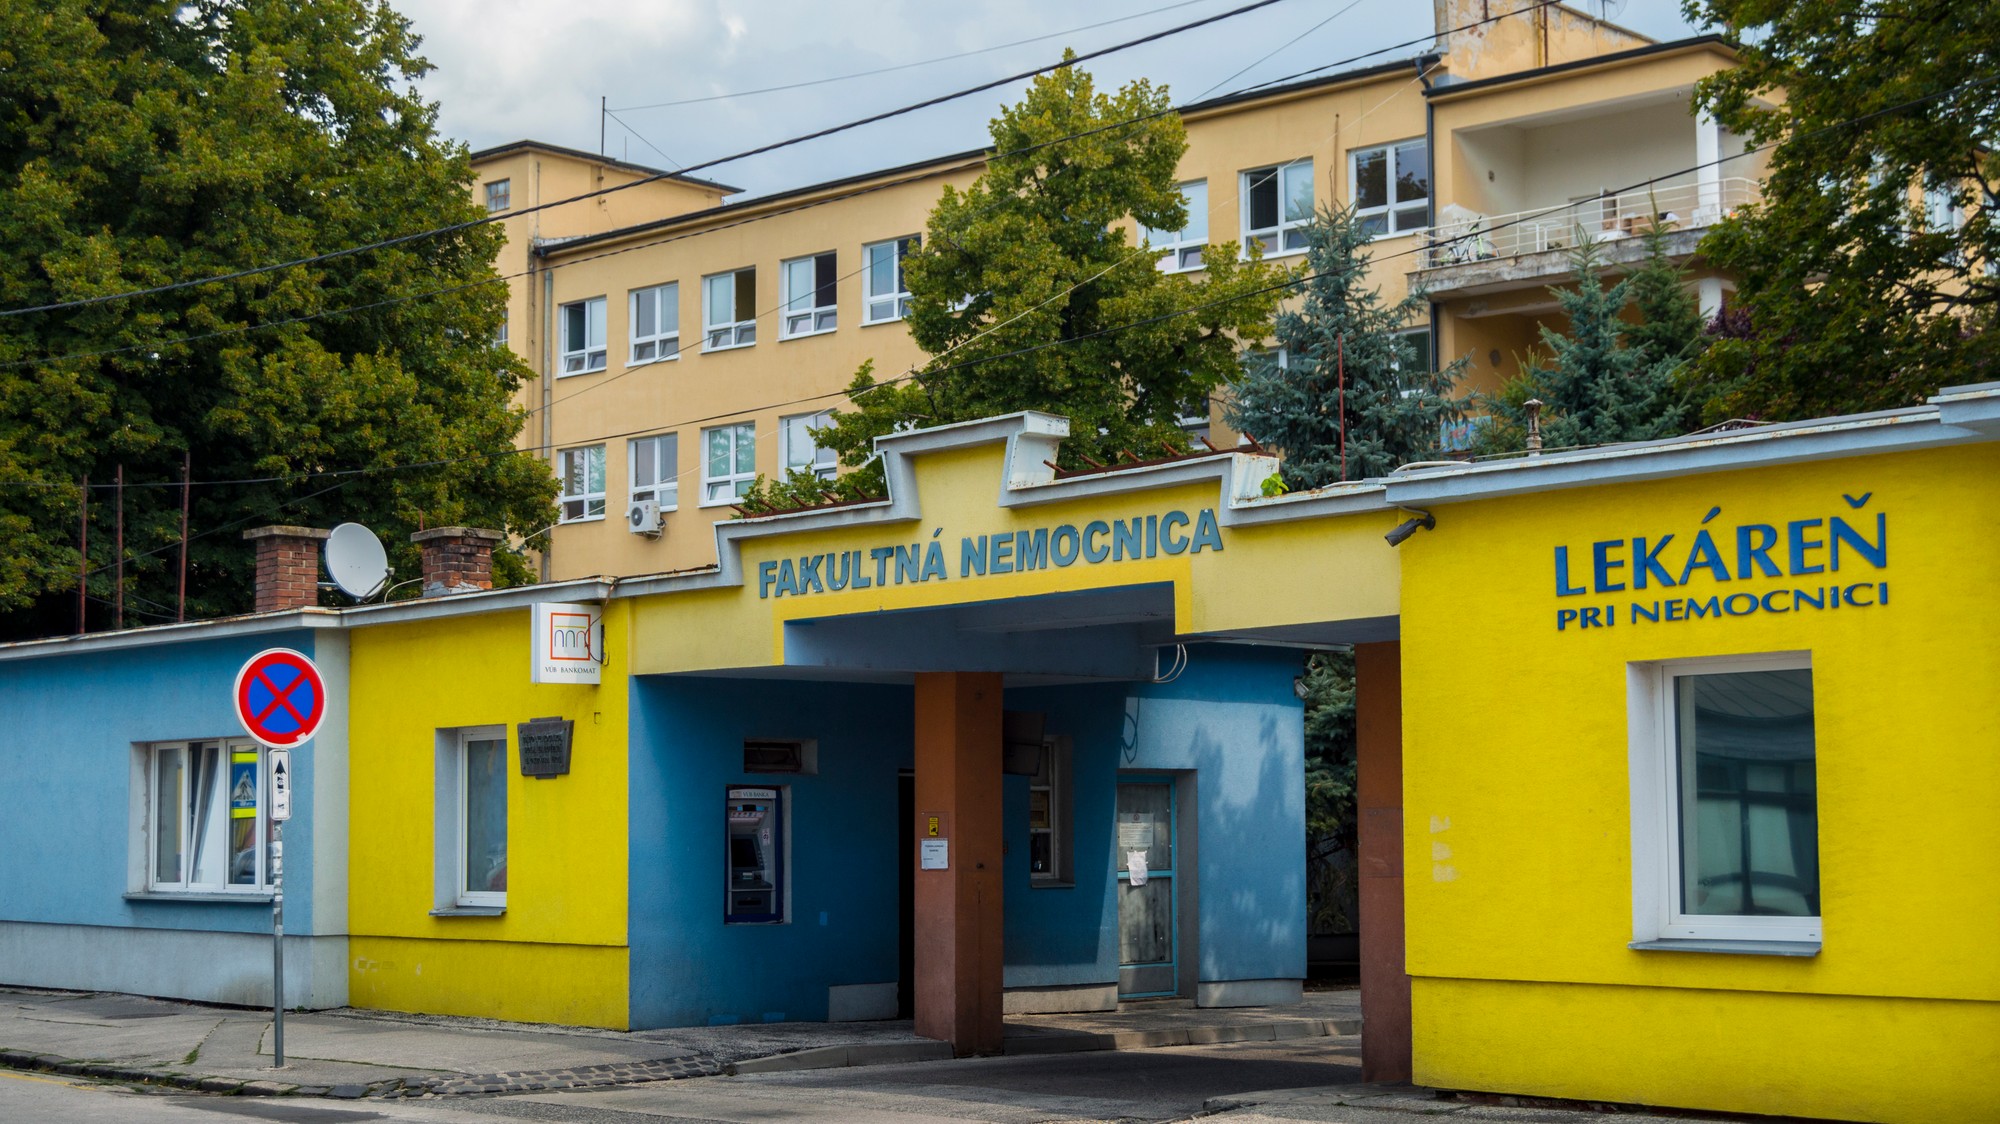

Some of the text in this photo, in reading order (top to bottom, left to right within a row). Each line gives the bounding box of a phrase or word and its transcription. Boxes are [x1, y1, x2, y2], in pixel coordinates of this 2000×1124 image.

[759, 508, 1224, 599] FAKULTNÁ NEMOCNICA
[1554, 492, 1887, 597] LEKÁREŇ
[1557, 582, 1889, 631] PRI NEMOCNICI
[560, 666, 597, 674] BANKOMAT
